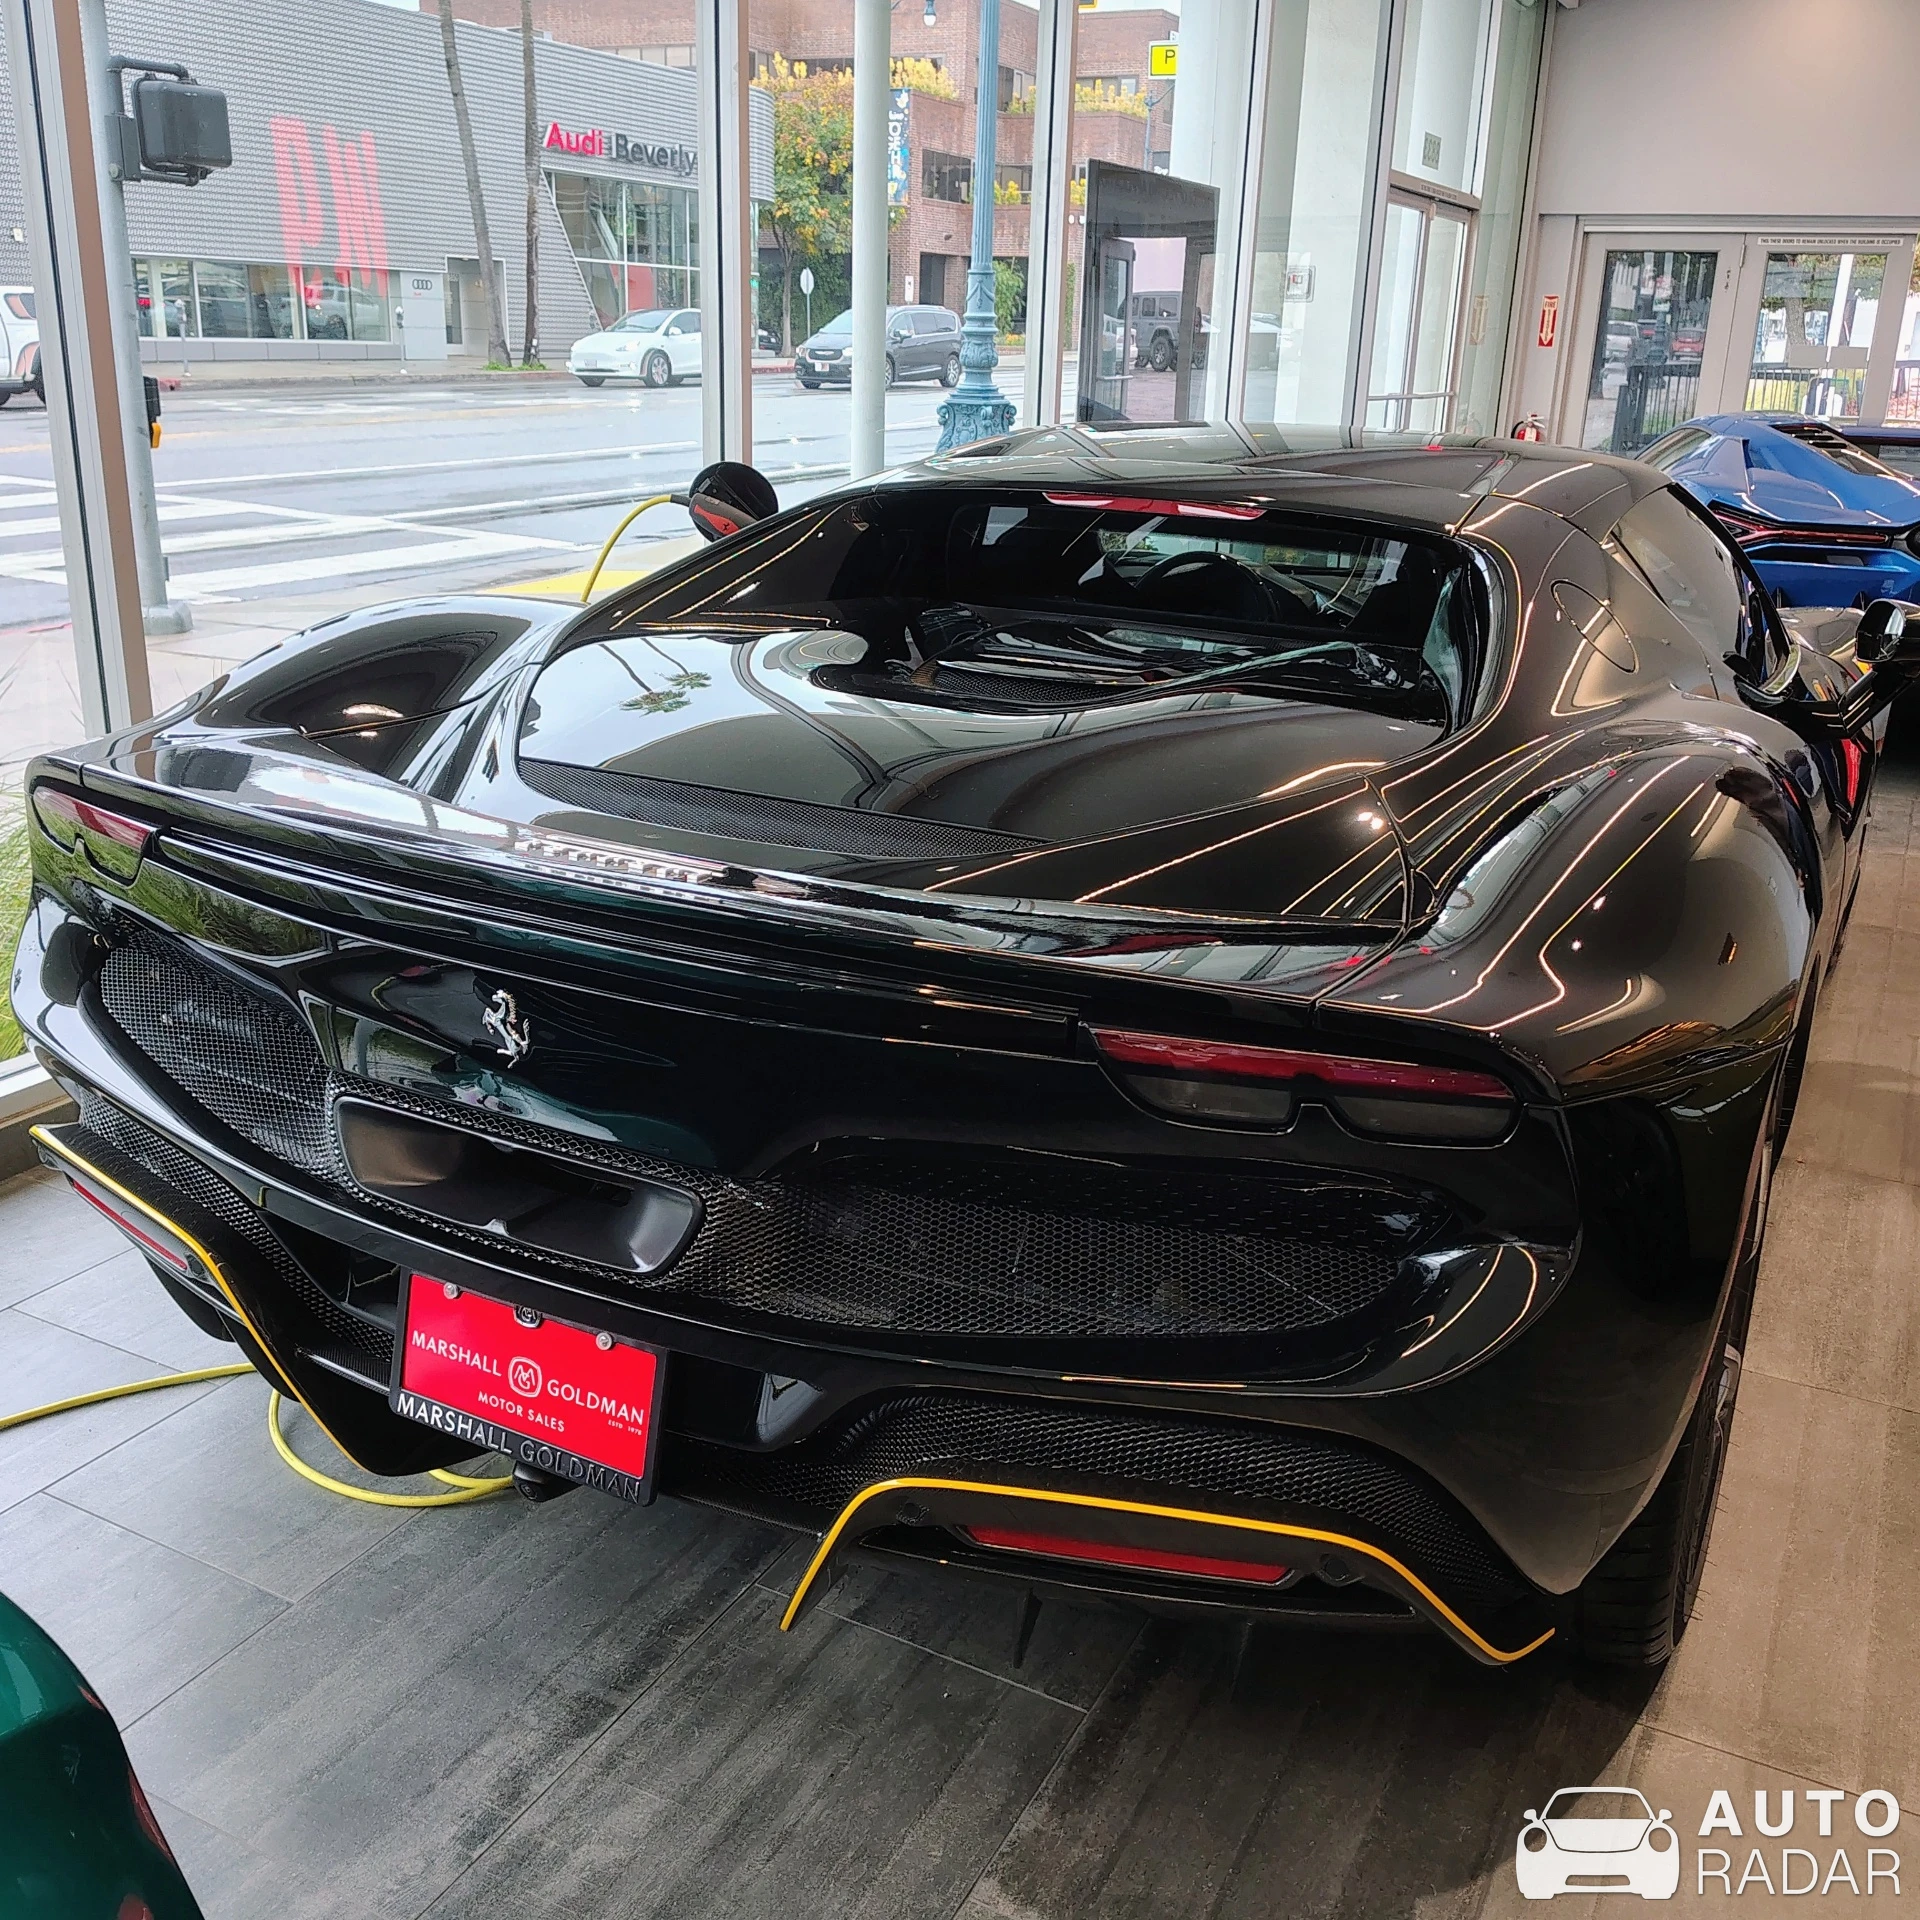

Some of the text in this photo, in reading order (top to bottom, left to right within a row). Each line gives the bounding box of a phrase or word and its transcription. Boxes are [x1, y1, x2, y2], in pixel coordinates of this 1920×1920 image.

[543, 121, 697, 176] Audi Beverly
[412, 1330, 645, 1426] MARSHALL GOLDMAN
[478, 1391, 565, 1433] MOTOR SALES
[397, 1393, 640, 1504] MARSHALL GOLDMAN
